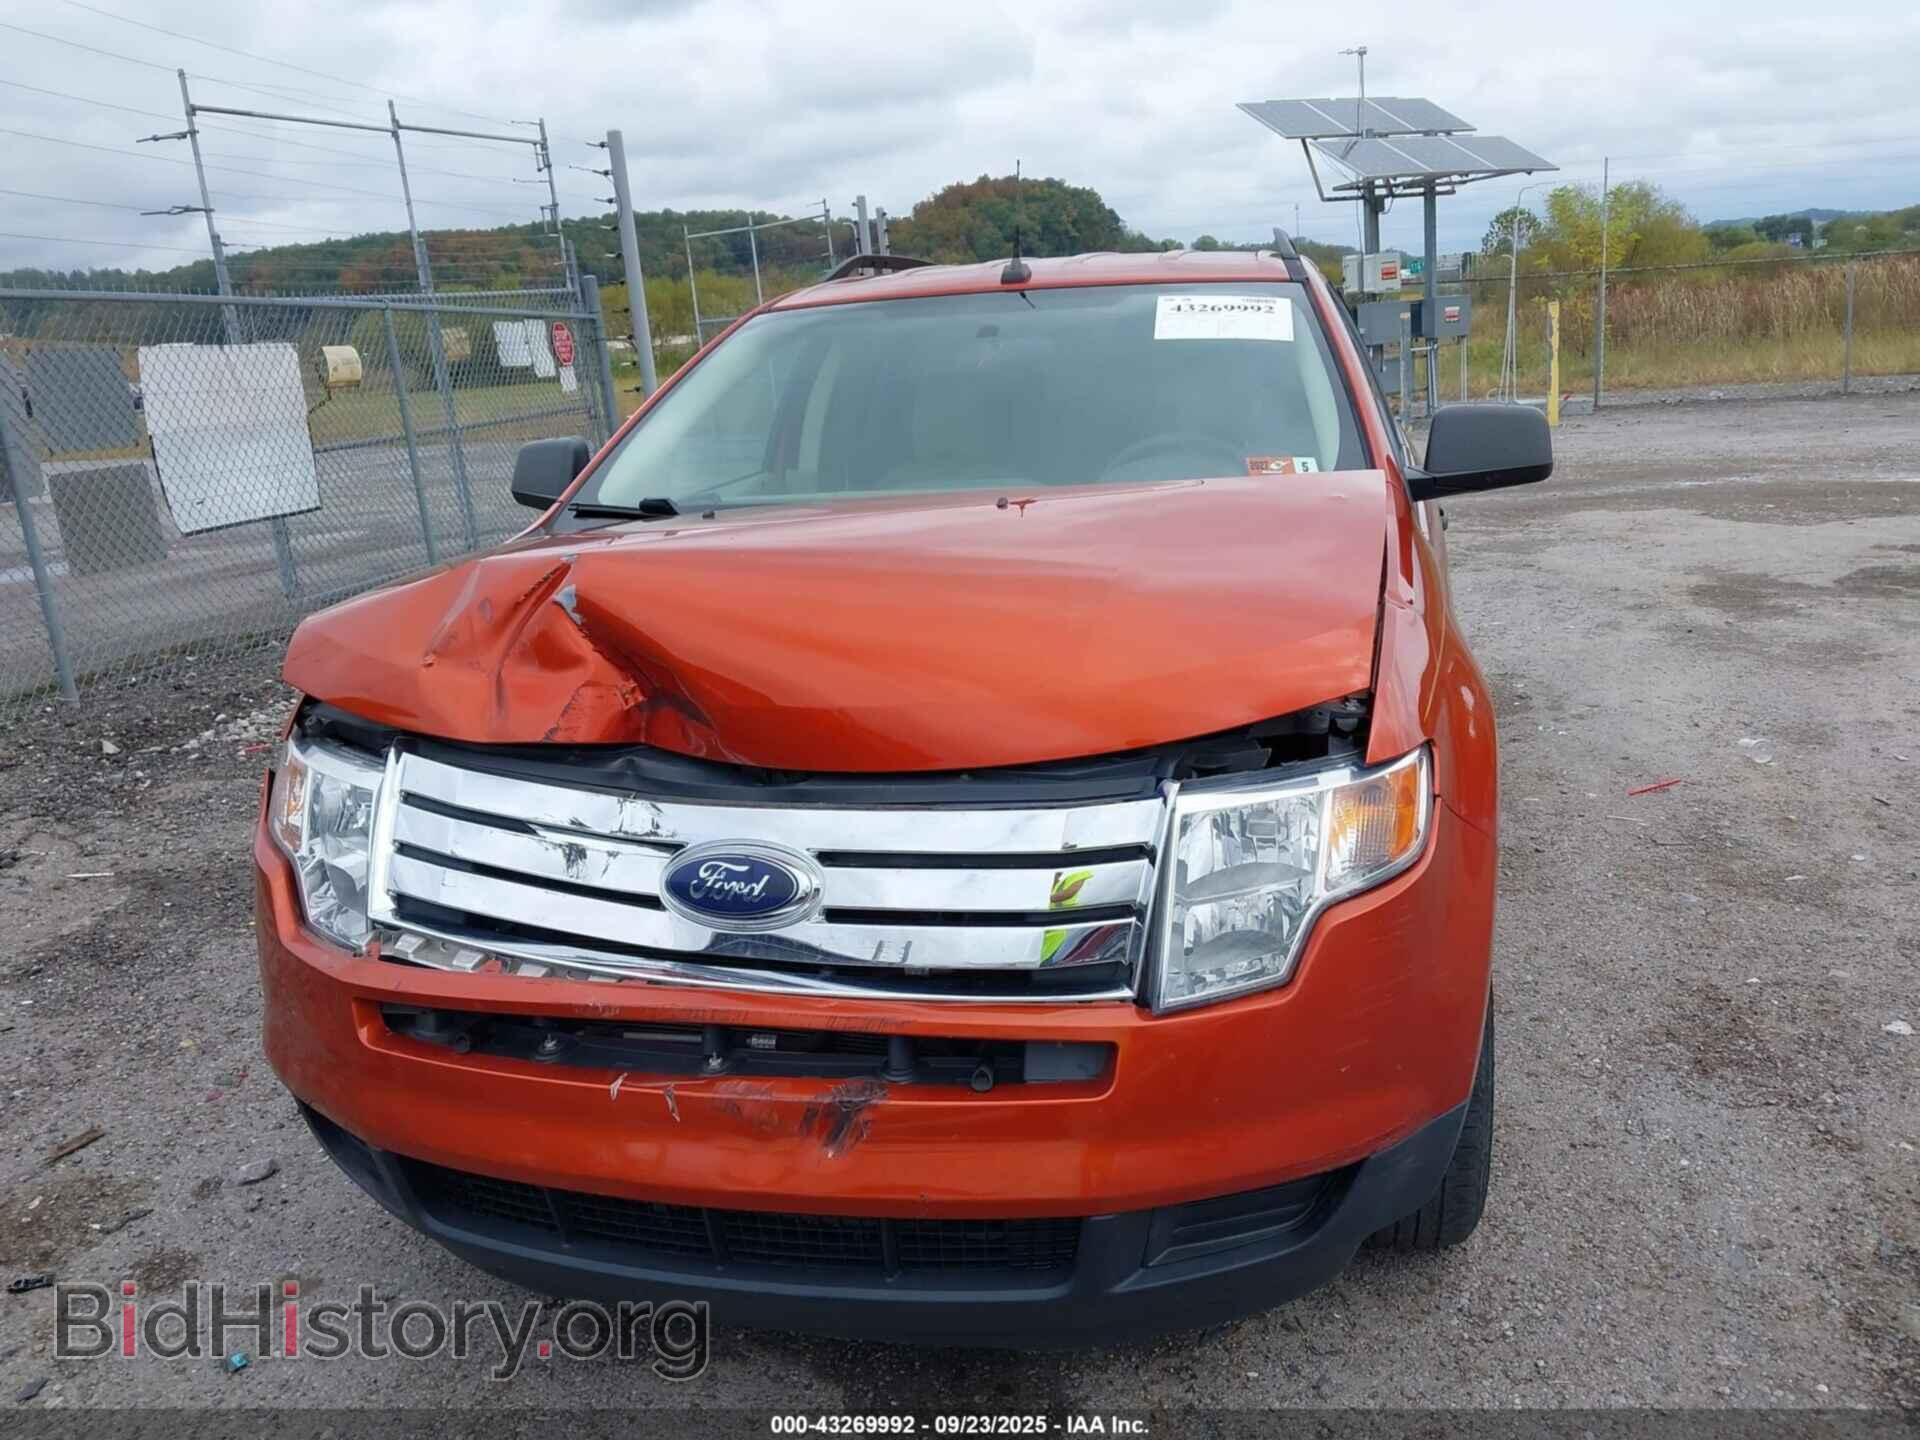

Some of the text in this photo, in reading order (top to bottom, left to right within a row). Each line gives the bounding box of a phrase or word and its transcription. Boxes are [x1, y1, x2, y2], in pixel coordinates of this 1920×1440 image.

[1170, 303, 1276, 315] 43269992
[1301, 461, 1310, 473] 5
[690, 860, 770, 898] Ford
